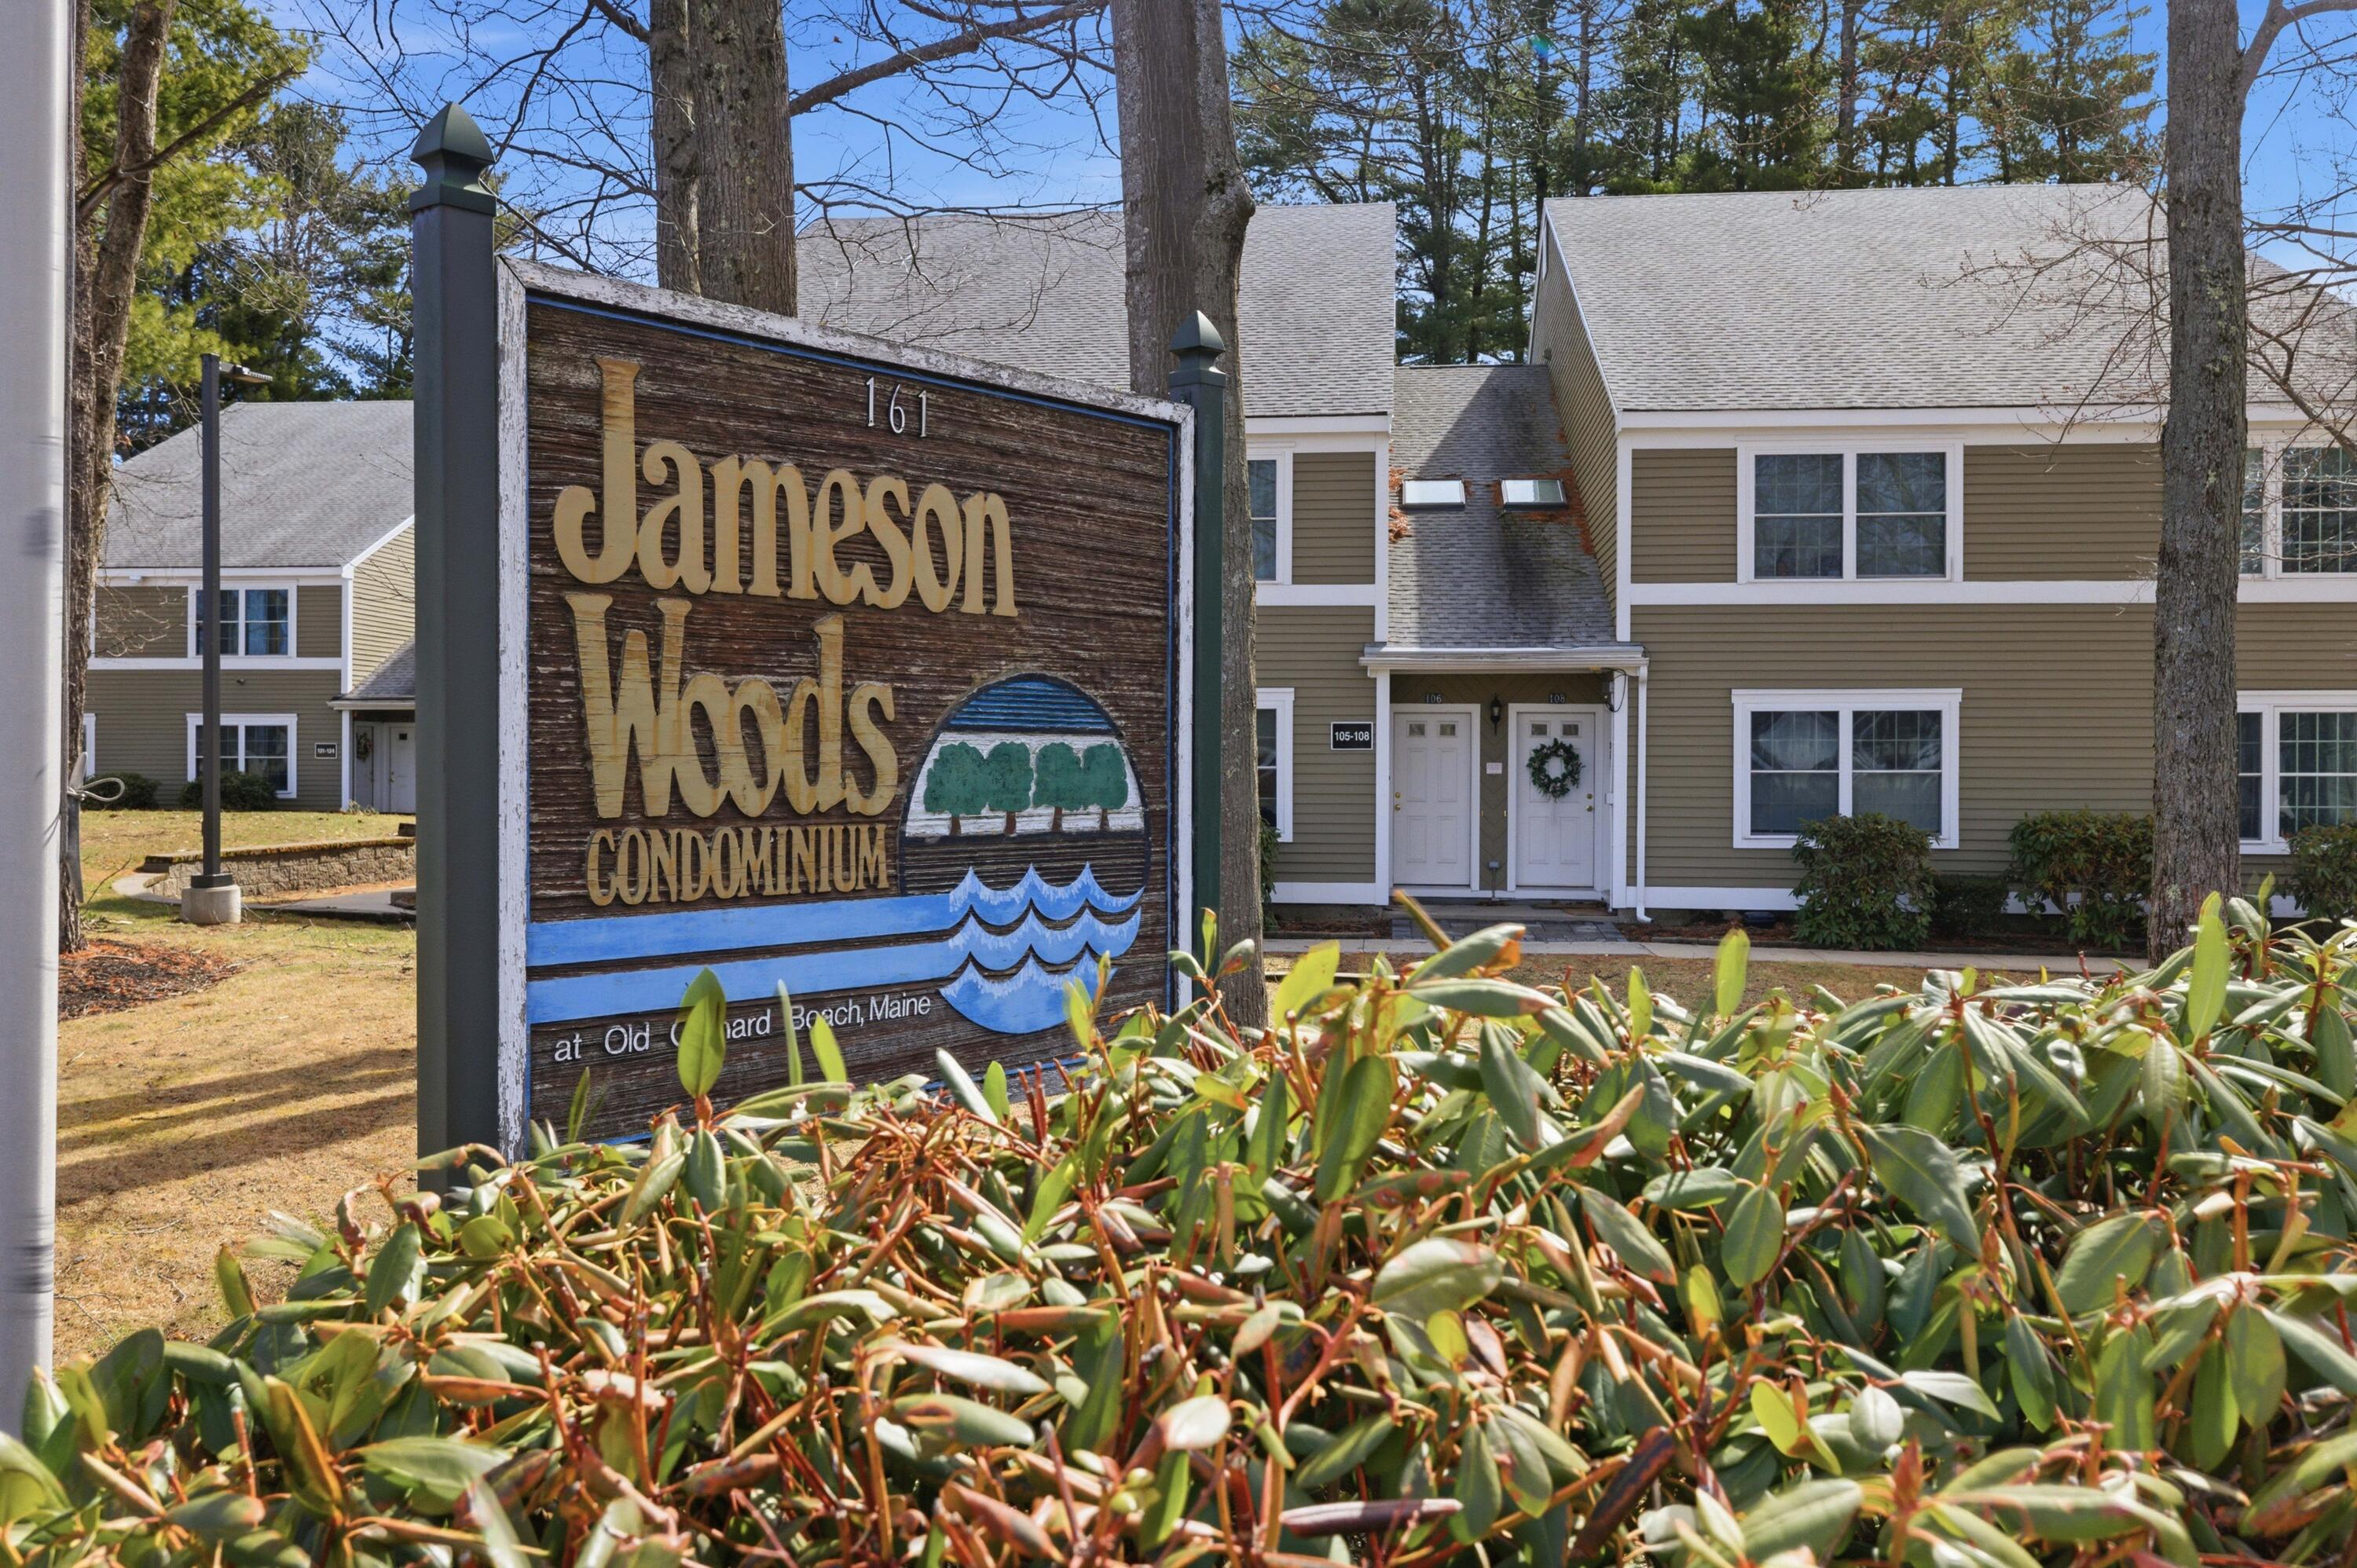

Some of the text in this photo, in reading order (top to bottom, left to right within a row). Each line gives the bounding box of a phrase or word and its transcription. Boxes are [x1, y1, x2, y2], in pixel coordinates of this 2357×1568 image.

[866, 376, 927, 438] 161
[553, 358, 1019, 617] Jameson
[564, 592, 899, 819] Woods
[1425, 693, 1442, 704] 106
[1549, 693, 1566, 704] 108
[1334, 731, 1370, 742] 105-108
[586, 825, 889, 907] CONDOMINIUM
[554, 1033, 583, 1061] at
[604, 1021, 651, 1055] Old
[869, 992, 931, 1021] Maine
